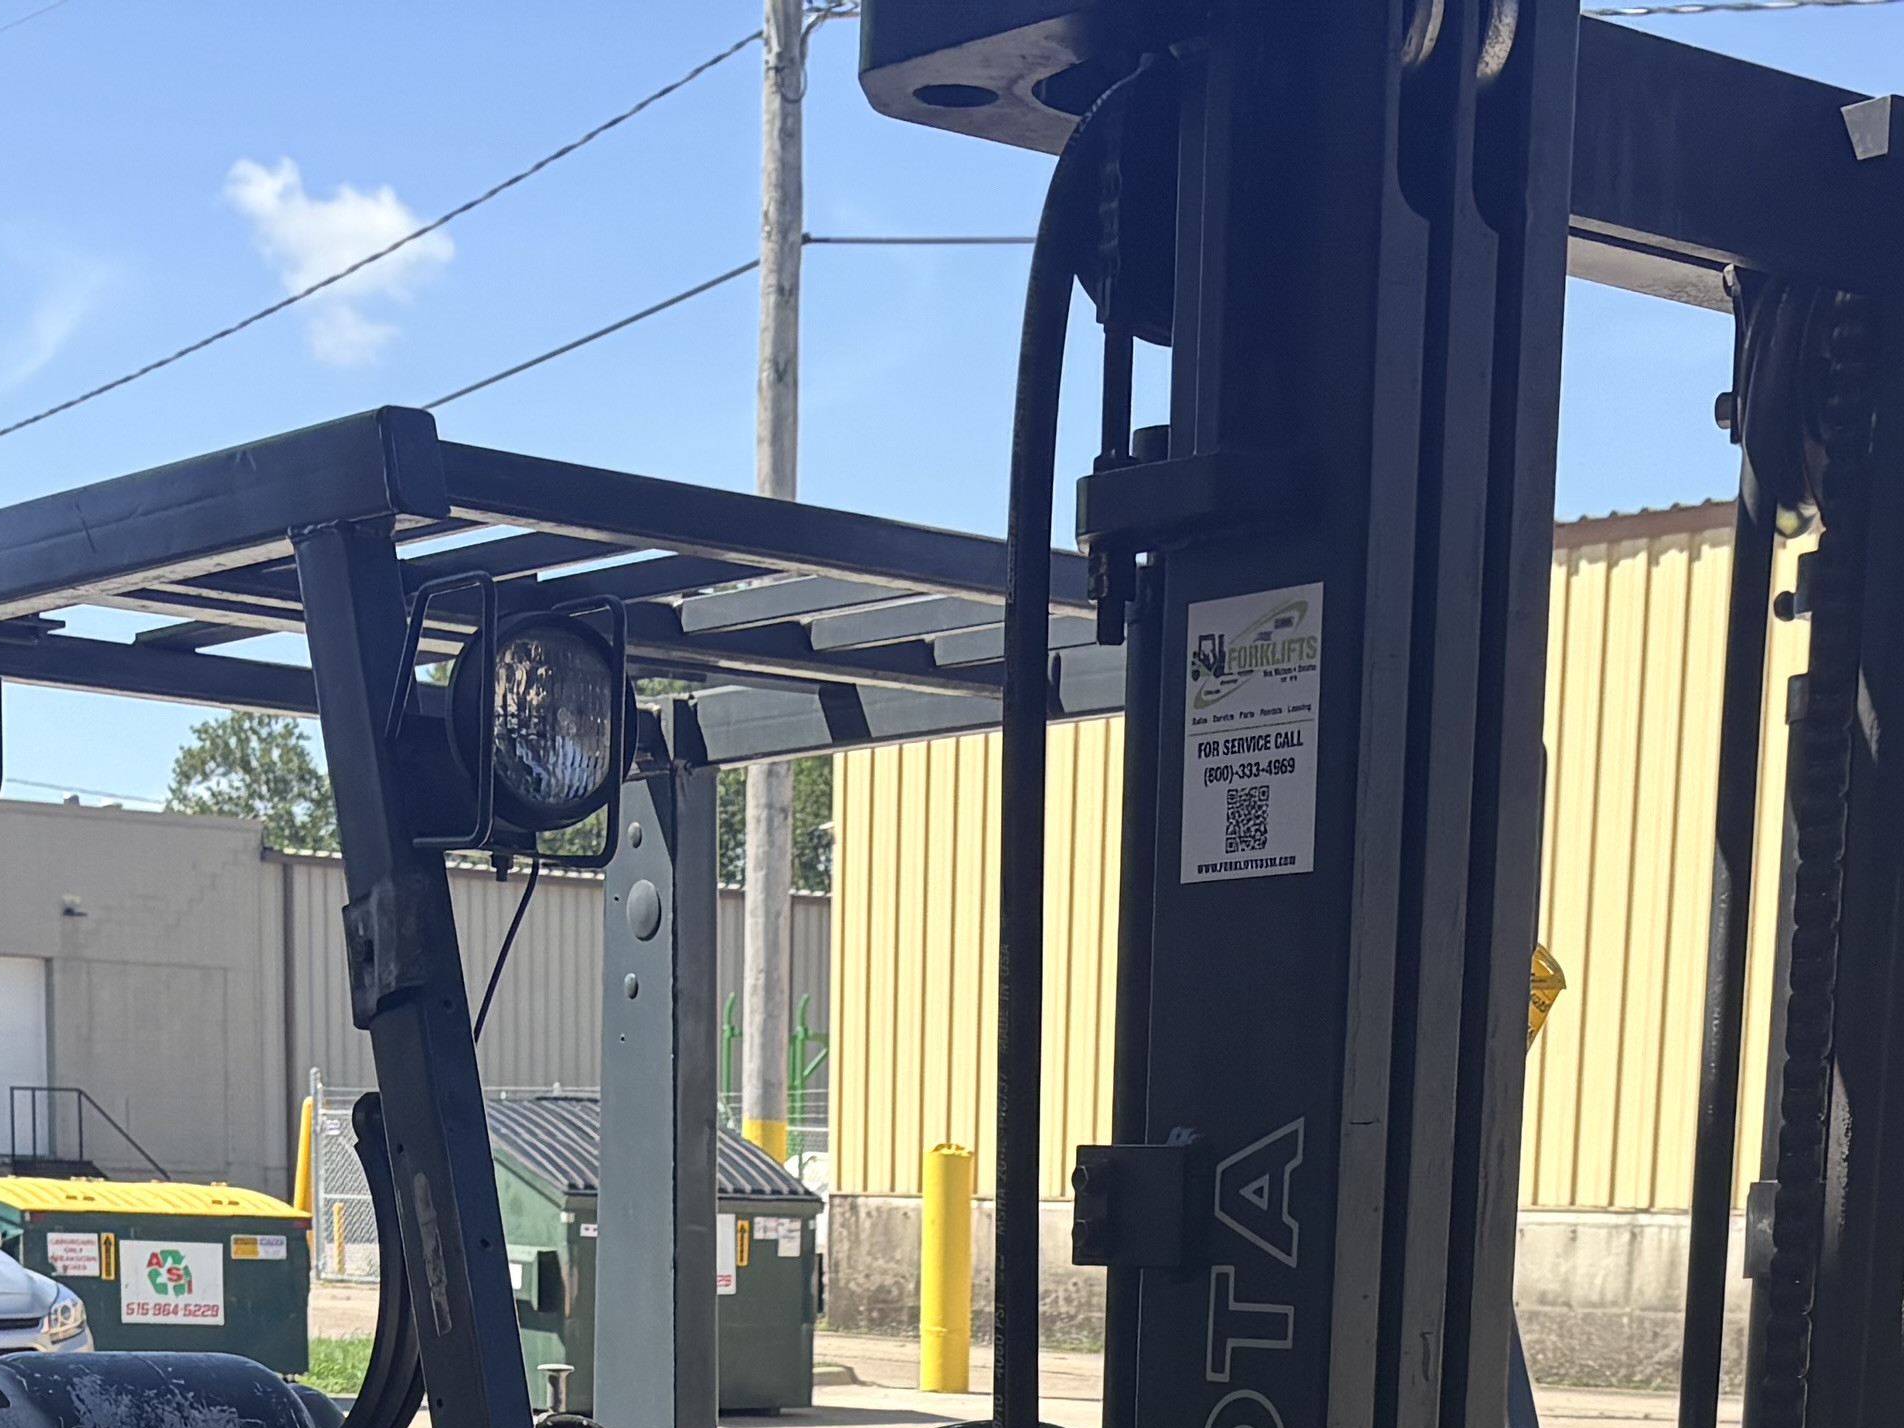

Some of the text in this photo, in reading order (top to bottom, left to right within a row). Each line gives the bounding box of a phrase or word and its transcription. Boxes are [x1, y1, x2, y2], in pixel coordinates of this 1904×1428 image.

[1227, 635, 1318, 672] FORKLIFTS
[1198, 728, 1304, 759] FOR SERVICE CALL
[999, 943, 1010, 976] USA
